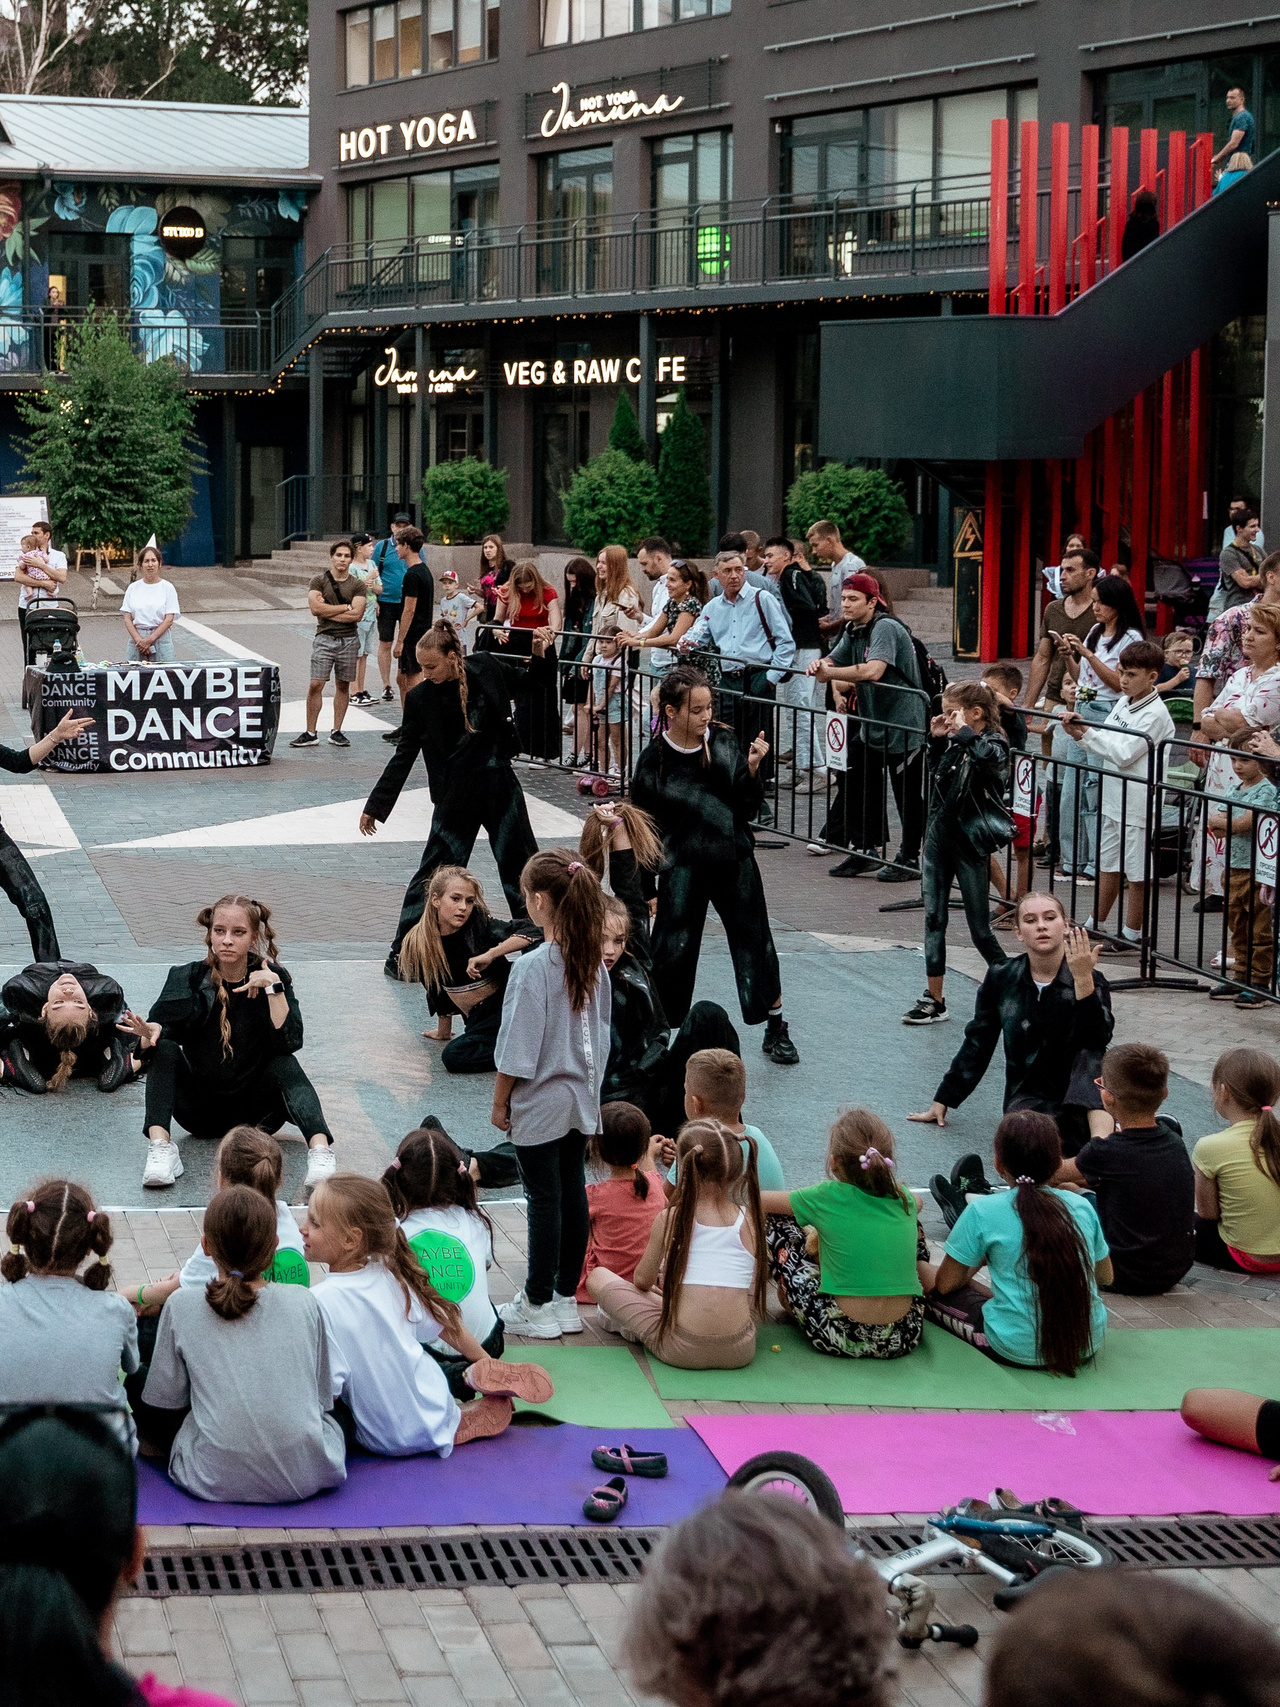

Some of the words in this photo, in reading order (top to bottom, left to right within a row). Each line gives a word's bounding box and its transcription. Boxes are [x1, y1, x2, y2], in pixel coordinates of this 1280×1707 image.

[580, 93, 603, 111] HOT
[606, 89, 637, 107] YOGA
[340, 124, 393, 162] HOT
[400, 110, 477, 151] YOGA
[503, 360, 545, 385] VEG
[552, 360, 566, 384] &
[573, 358, 621, 384] RAW
[625, 356, 686, 383] CFE
[41, 683, 97, 697] DANCE
[107, 667, 264, 701] MAYBE
[41, 698, 97, 708] Community
[107, 705, 263, 742] DANCE
[109, 744, 262, 771] Community
[421, 1246, 463, 1261] AYBE
[431, 1264, 465, 1278] NCE
